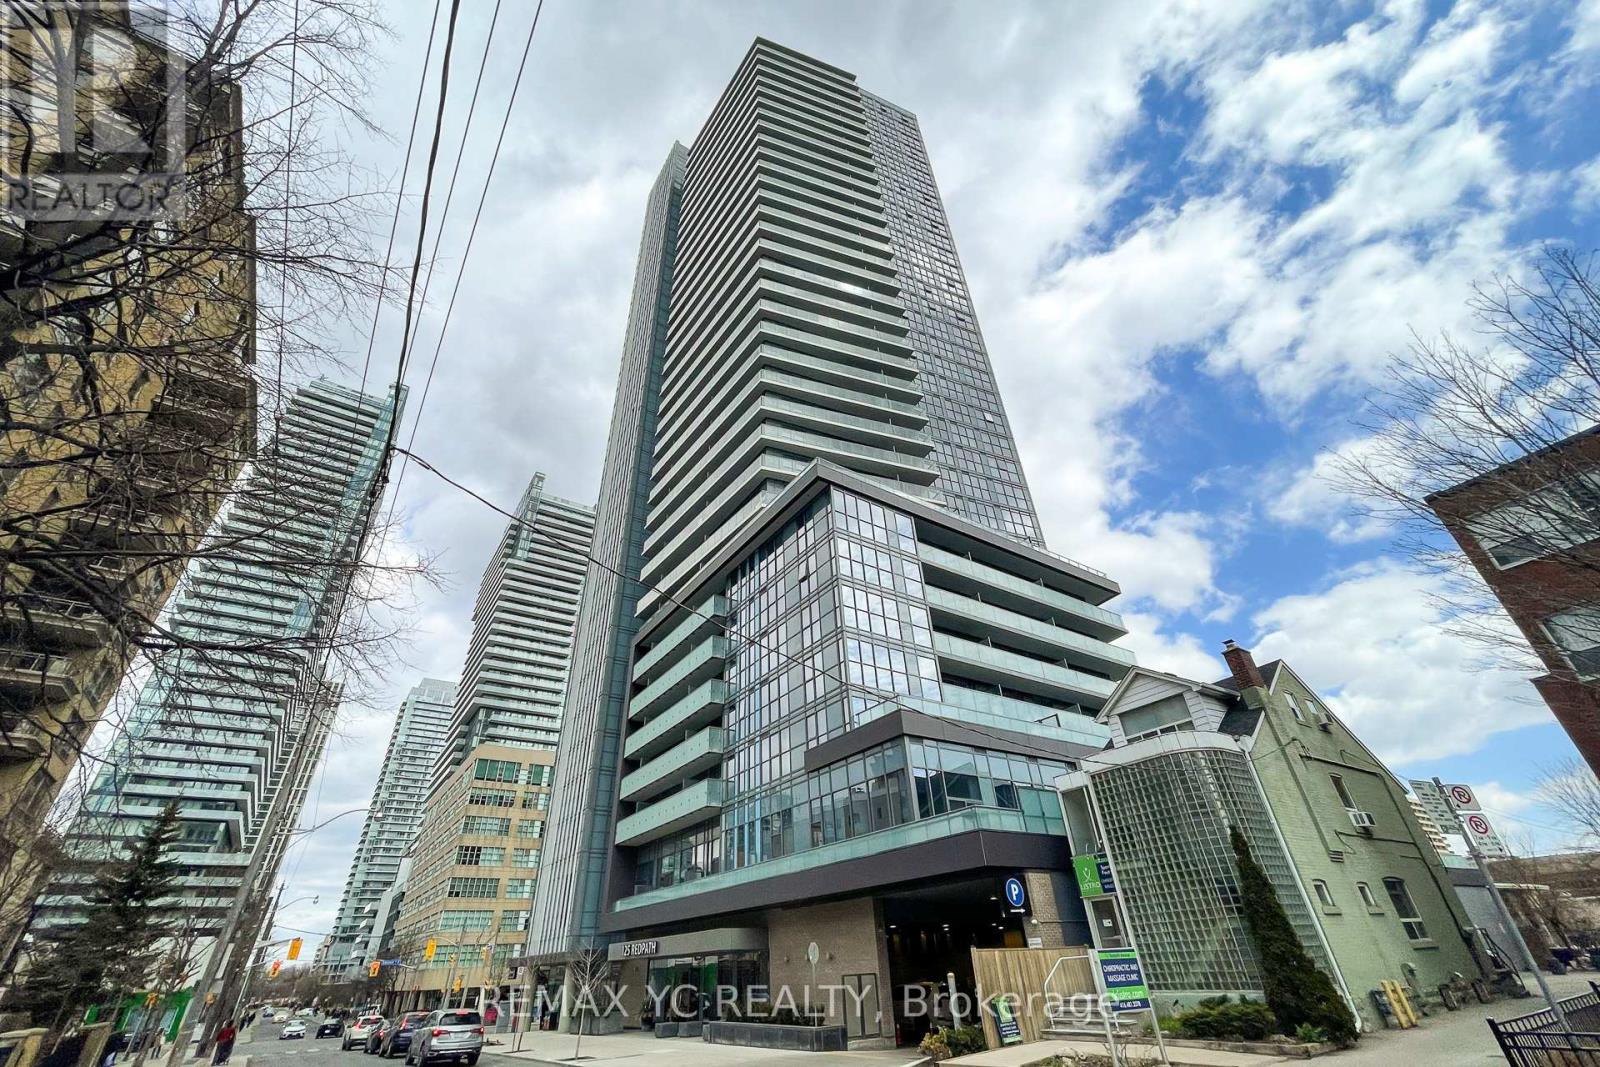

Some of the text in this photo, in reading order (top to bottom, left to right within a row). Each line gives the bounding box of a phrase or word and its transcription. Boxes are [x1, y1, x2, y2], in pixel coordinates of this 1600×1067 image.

[630, 941, 657, 955] REDPATH
[1107, 973, 1139, 982] MASSAGE CLINIC
